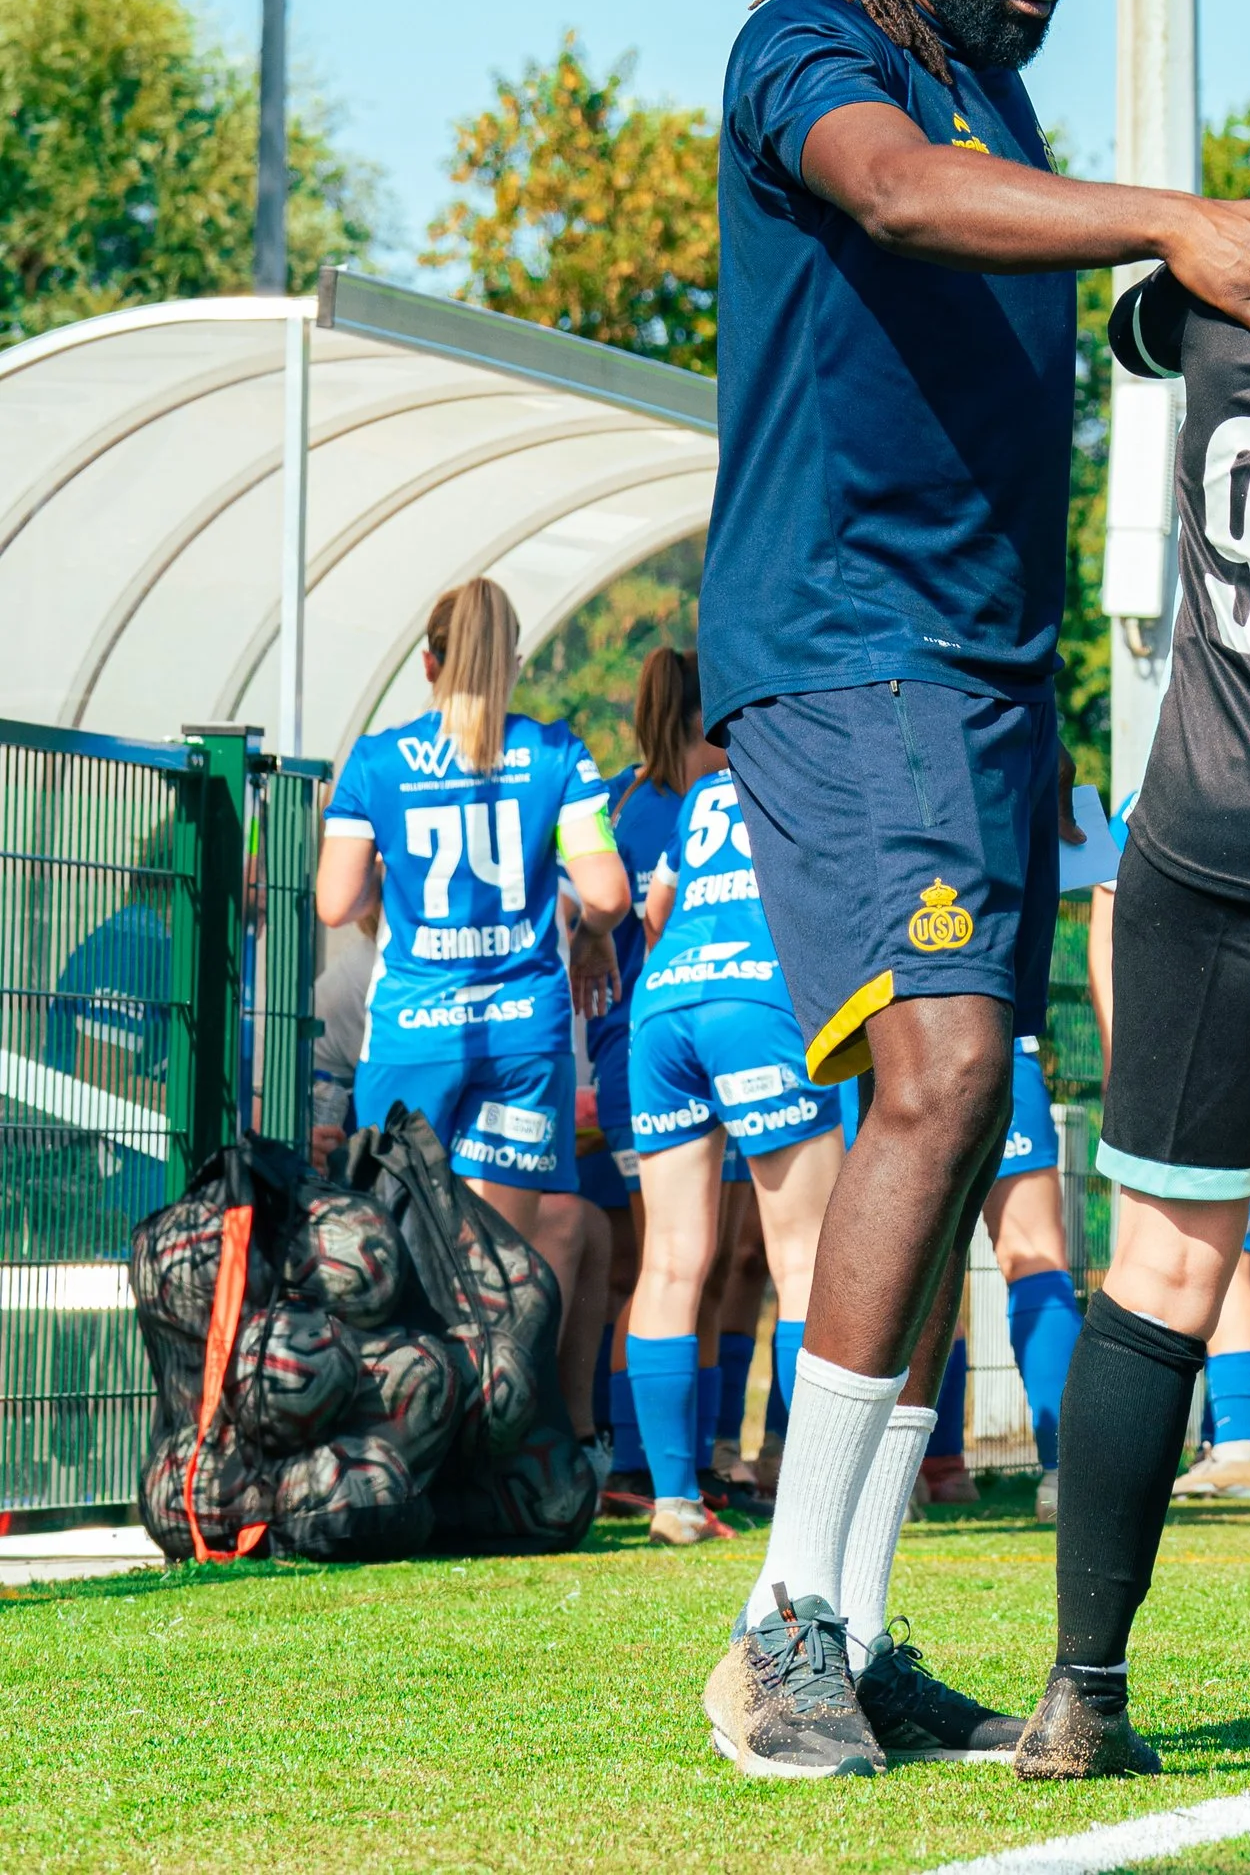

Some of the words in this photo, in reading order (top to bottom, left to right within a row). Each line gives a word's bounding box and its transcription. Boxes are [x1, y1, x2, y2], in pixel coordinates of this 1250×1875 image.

[684, 782, 752, 869] 5
[405, 798, 526, 919] 74
[916, 915, 967, 942] USG
[646, 960, 774, 991] CARGLASS
[398, 998, 534, 1029] CARGLASS
